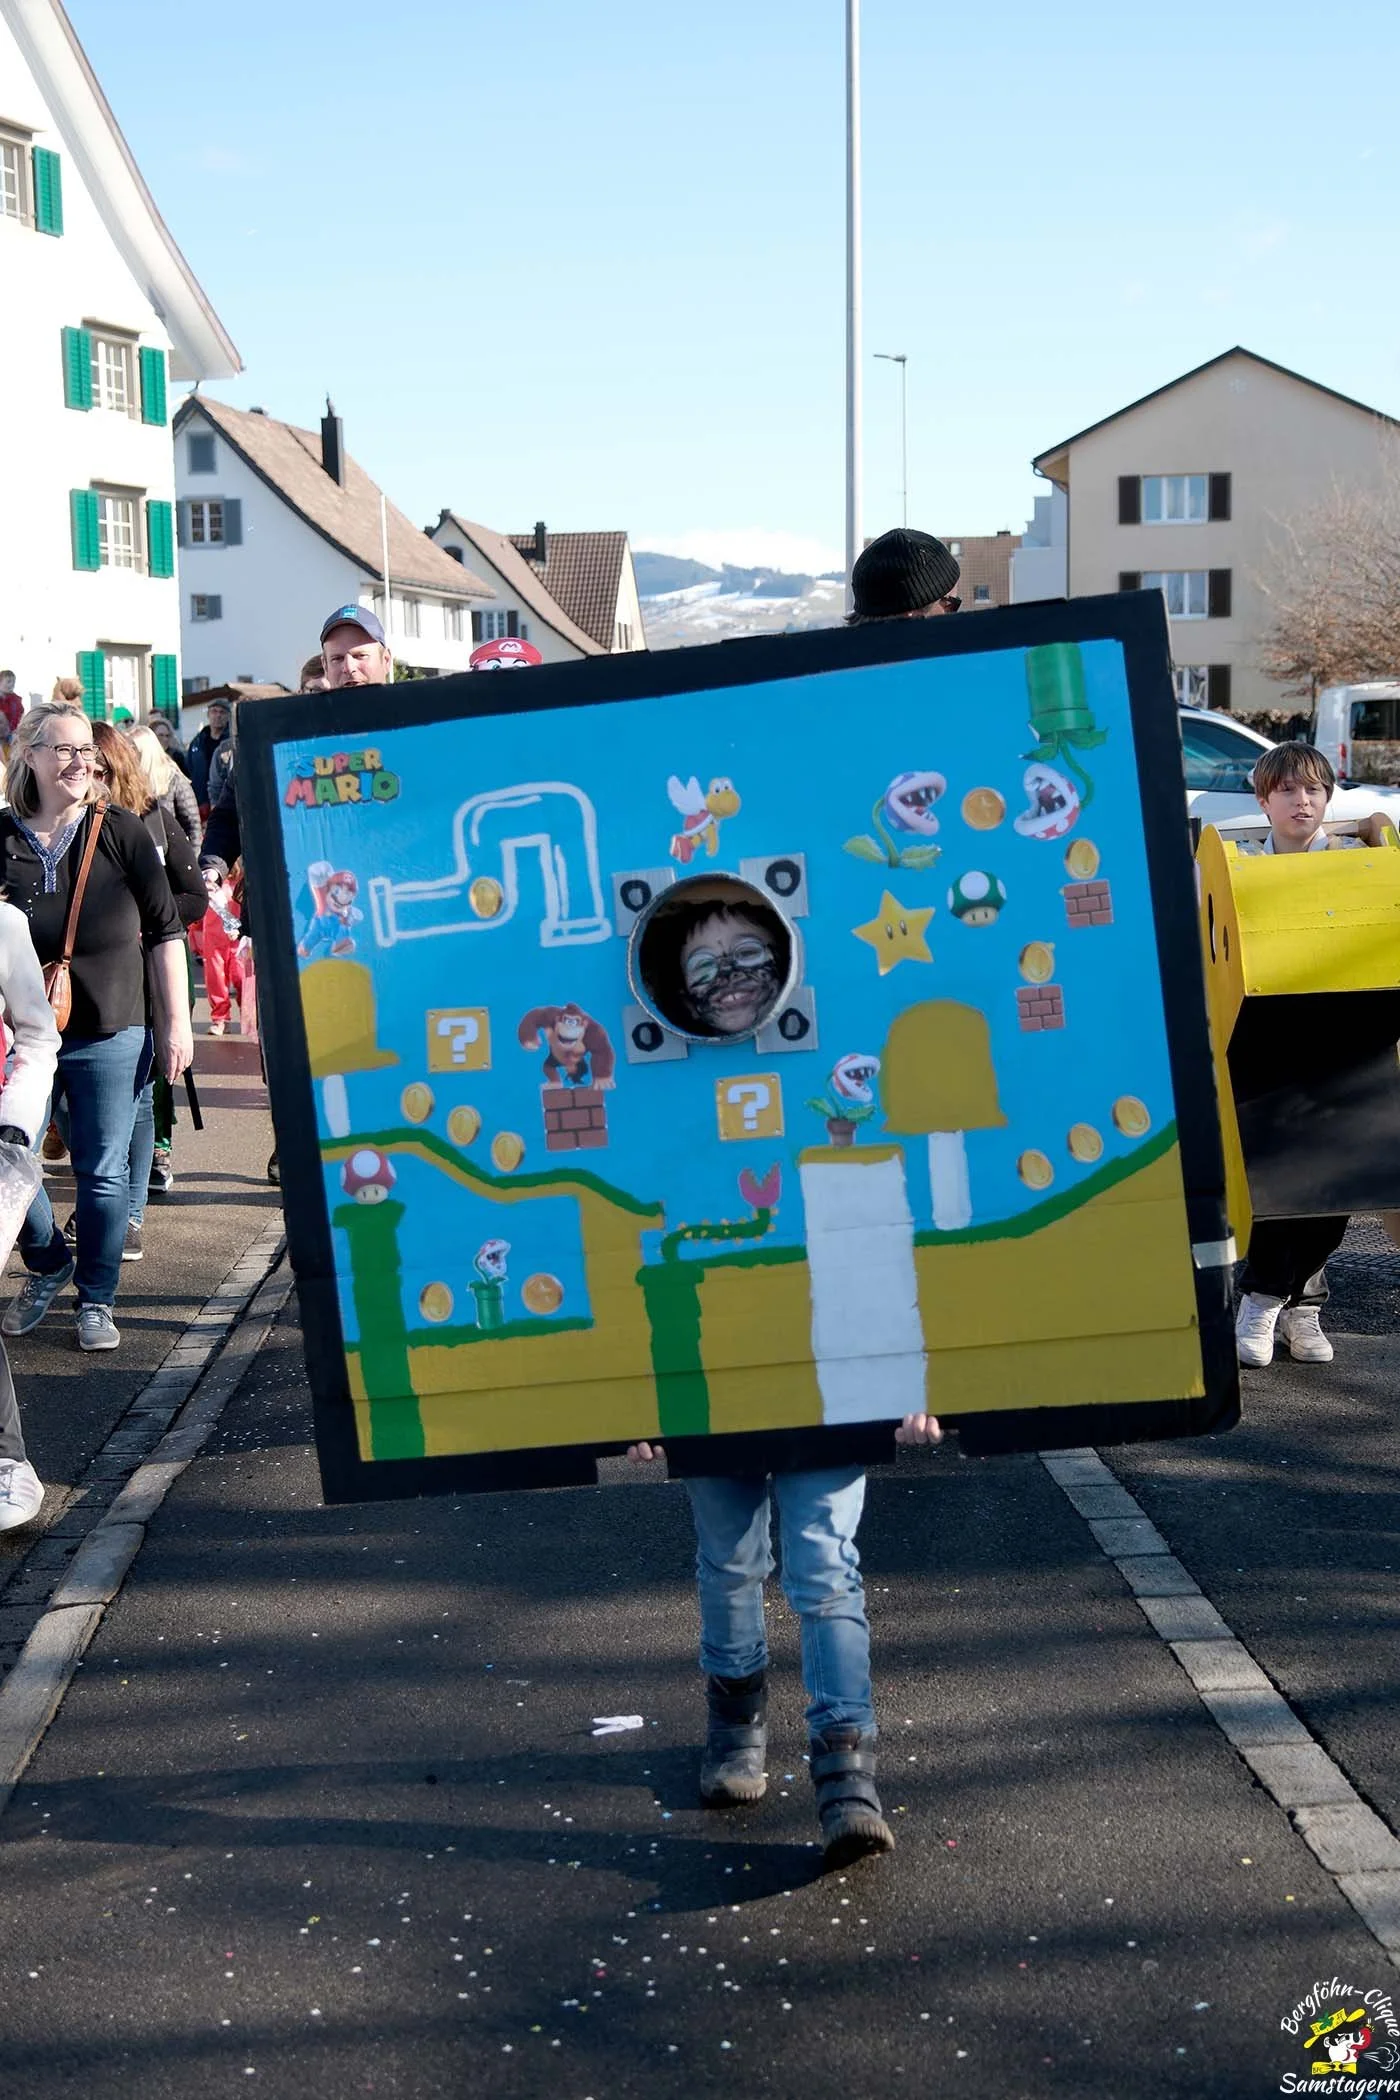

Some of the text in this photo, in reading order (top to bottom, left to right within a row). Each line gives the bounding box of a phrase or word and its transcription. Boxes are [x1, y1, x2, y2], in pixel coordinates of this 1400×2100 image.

[500, 642, 519, 653] M
[291, 748, 382, 778] SUPER
[285, 771, 400, 808] MARIO
